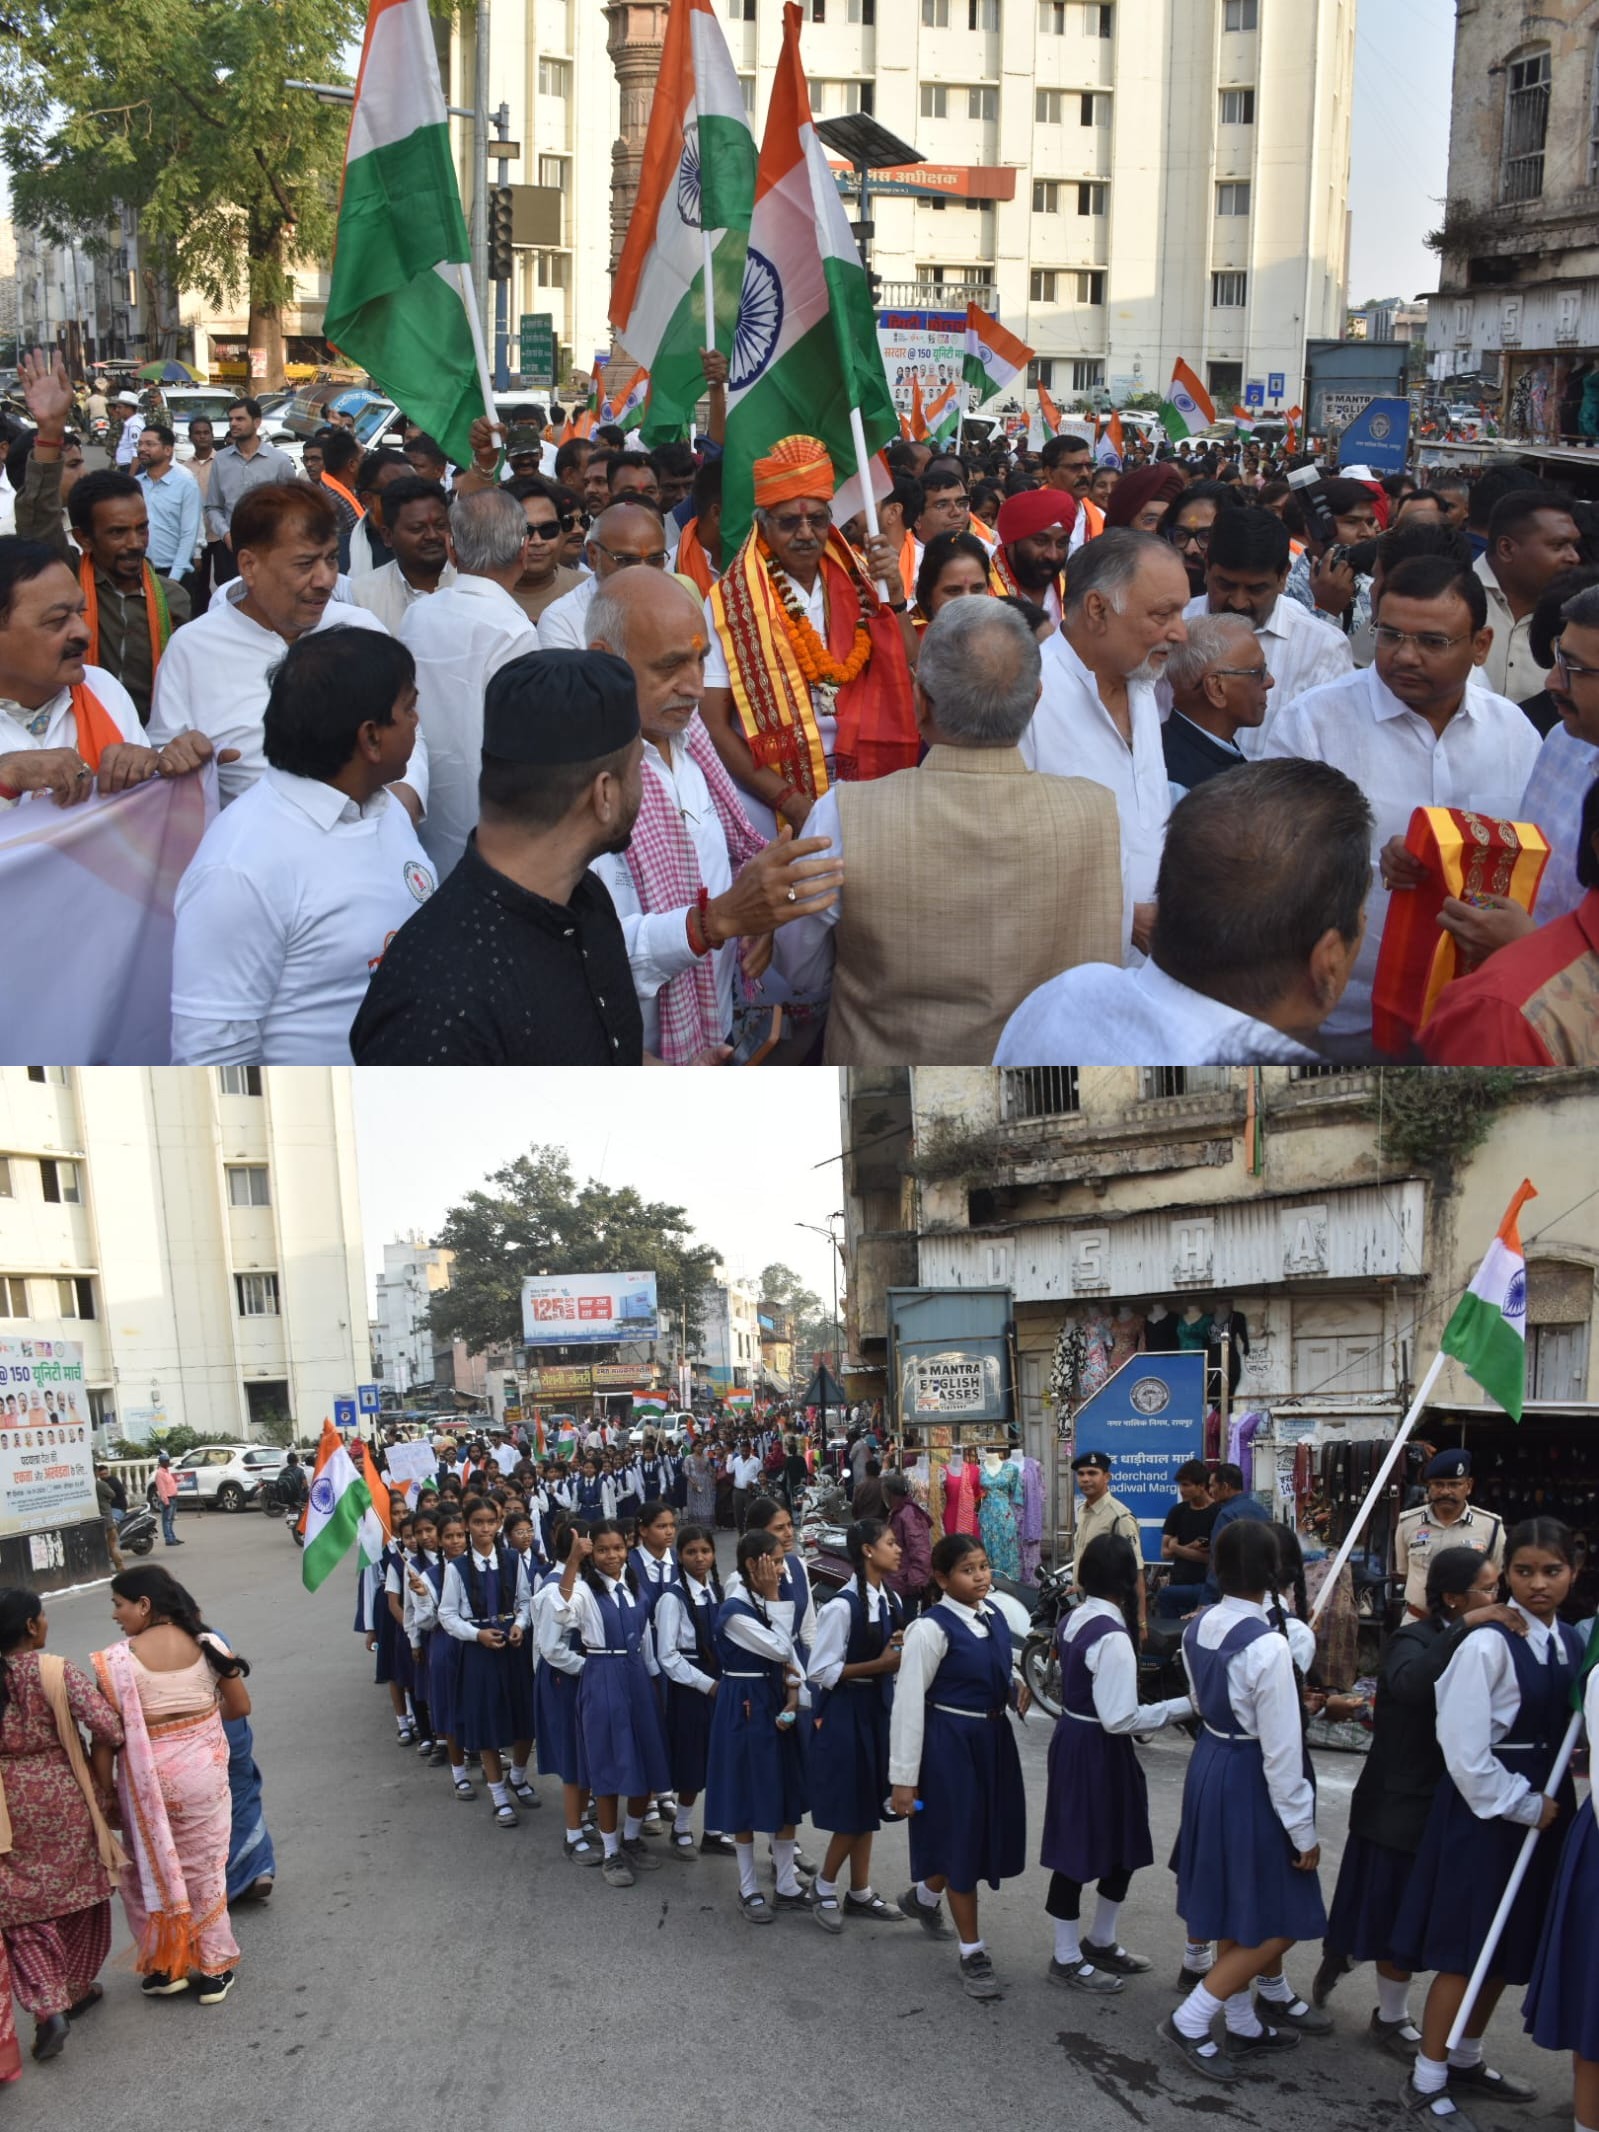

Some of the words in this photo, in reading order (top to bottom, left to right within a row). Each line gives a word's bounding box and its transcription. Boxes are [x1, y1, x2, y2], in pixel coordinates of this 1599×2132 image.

[895, 169, 959, 185] अधीक्षक
[907, 347, 917, 360] @
[918, 348, 931, 359] 150
[933, 346, 954, 362] यूनिटी
[531, 1298, 565, 1321] 125
[10, 1366, 30, 1382] 150
[32, 1361, 61, 1388] यूनिटी
[63, 1361, 82, 1380] मार्च
[930, 1364, 980, 1376] MANTRA
[920, 1377, 980, 1390] EGLISH
[939, 1389, 980, 1401] ASSES
[1123, 1418, 1147, 1427] पालिक
[1171, 1419, 1193, 1428] रायपुर
[1120, 1452, 1169, 1466] धाड़ीवाल
[1171, 1451, 1196, 1464] मार्ग
[1109, 1470, 1168, 1481] nderchand
[1108, 1483, 1146, 1492] adiwal
[1149, 1483, 1177, 1495] Marg
